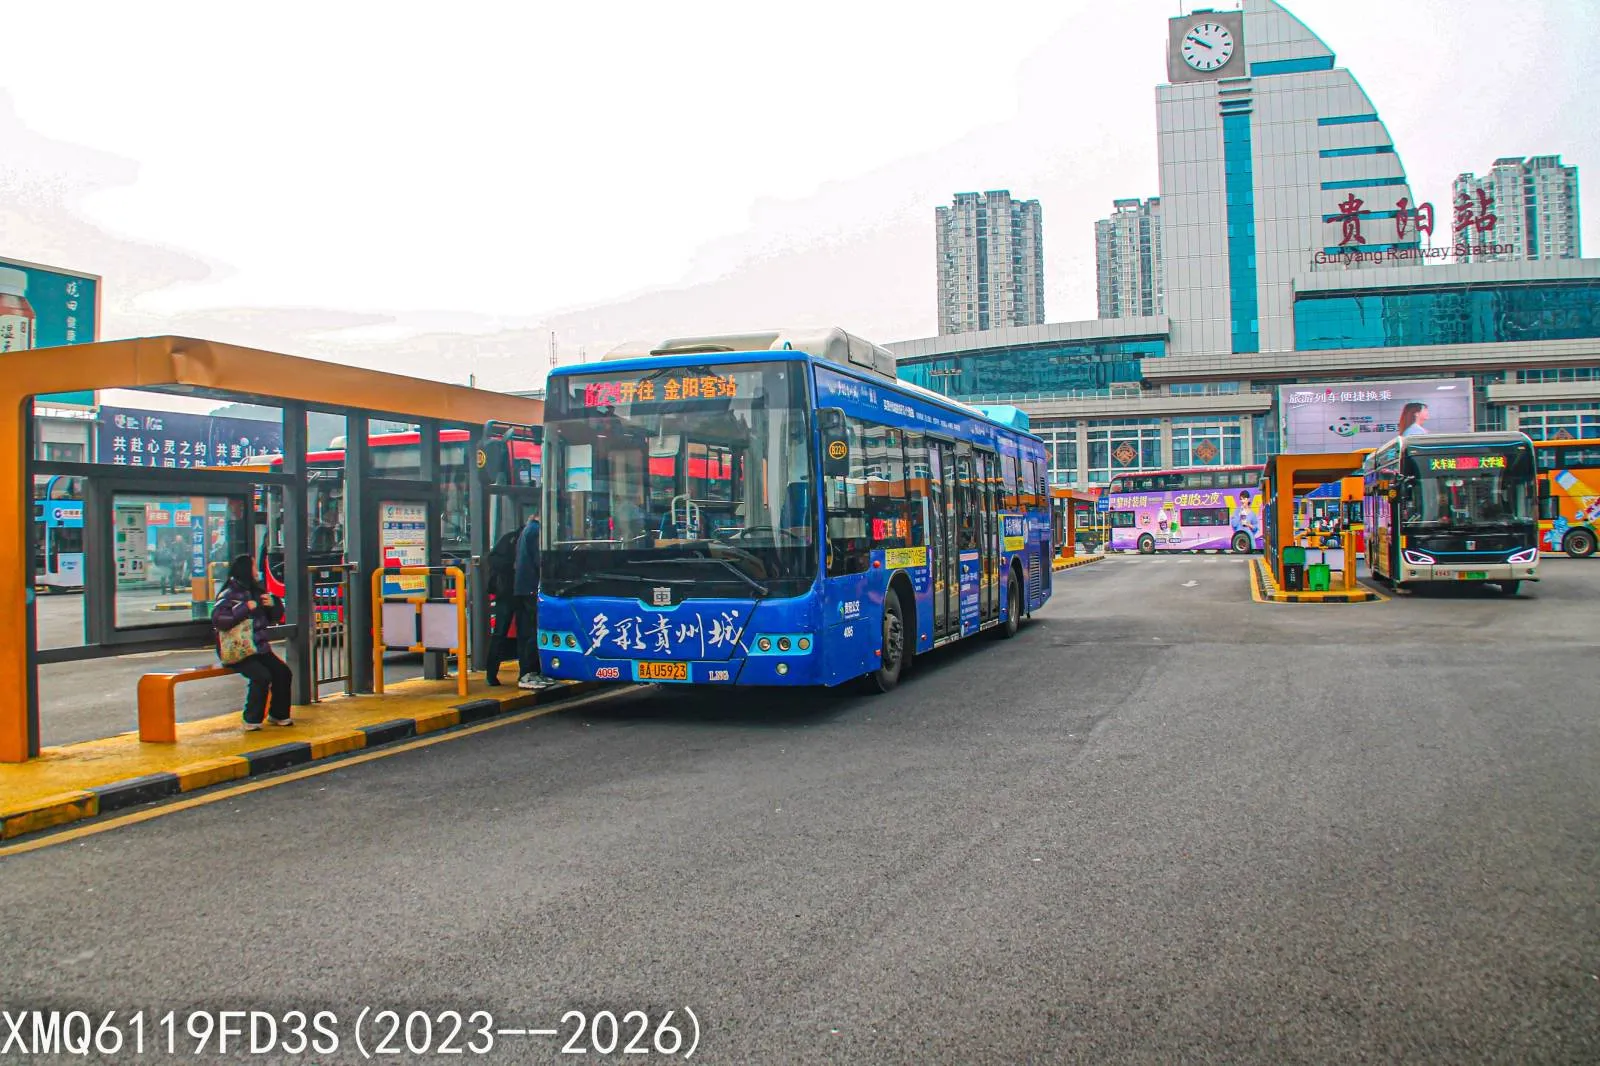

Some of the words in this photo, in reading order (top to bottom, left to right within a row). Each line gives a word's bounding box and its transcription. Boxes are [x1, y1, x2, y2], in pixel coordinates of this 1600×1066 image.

[1327, 188, 1498, 246] 贵阳站
[1387, 246, 1450, 262] Railway
[1455, 243, 1514, 258] Station
[664, 374, 738, 400] 金阳客站
[113, 436, 207, 457] 共赴心灵之约
[830, 443, 846, 454] B224
[596, 667, 619, 678] 4095
